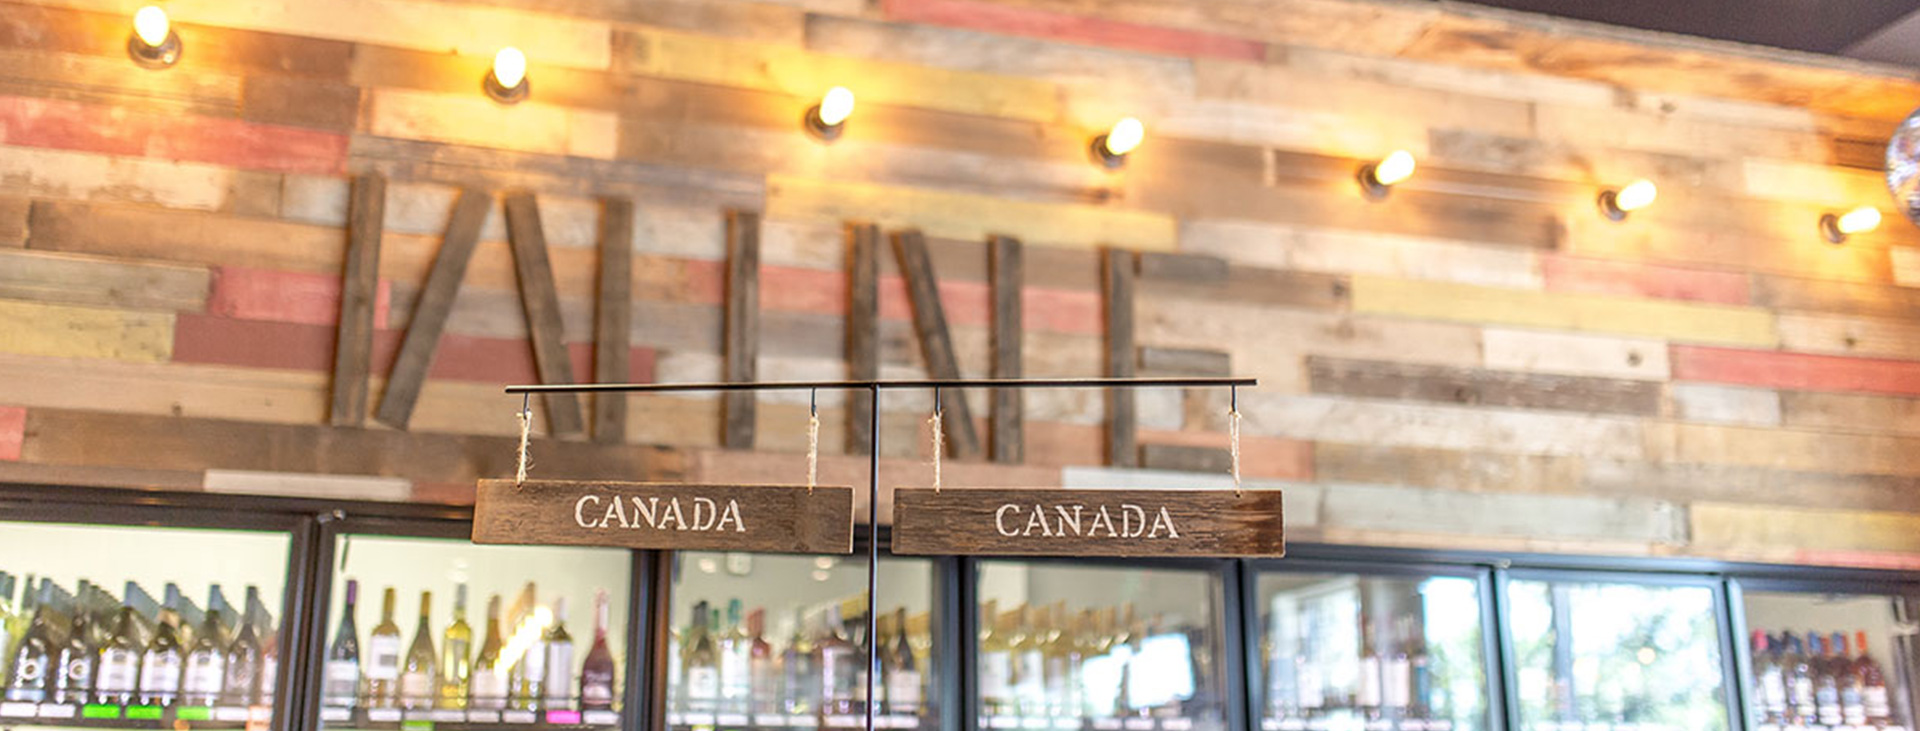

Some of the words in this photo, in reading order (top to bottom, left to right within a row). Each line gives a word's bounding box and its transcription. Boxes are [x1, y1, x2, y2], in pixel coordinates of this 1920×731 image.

[330, 171, 1231, 471] WINE
[574, 494, 746, 532] CANADA
[994, 503, 1179, 539] CANADA
